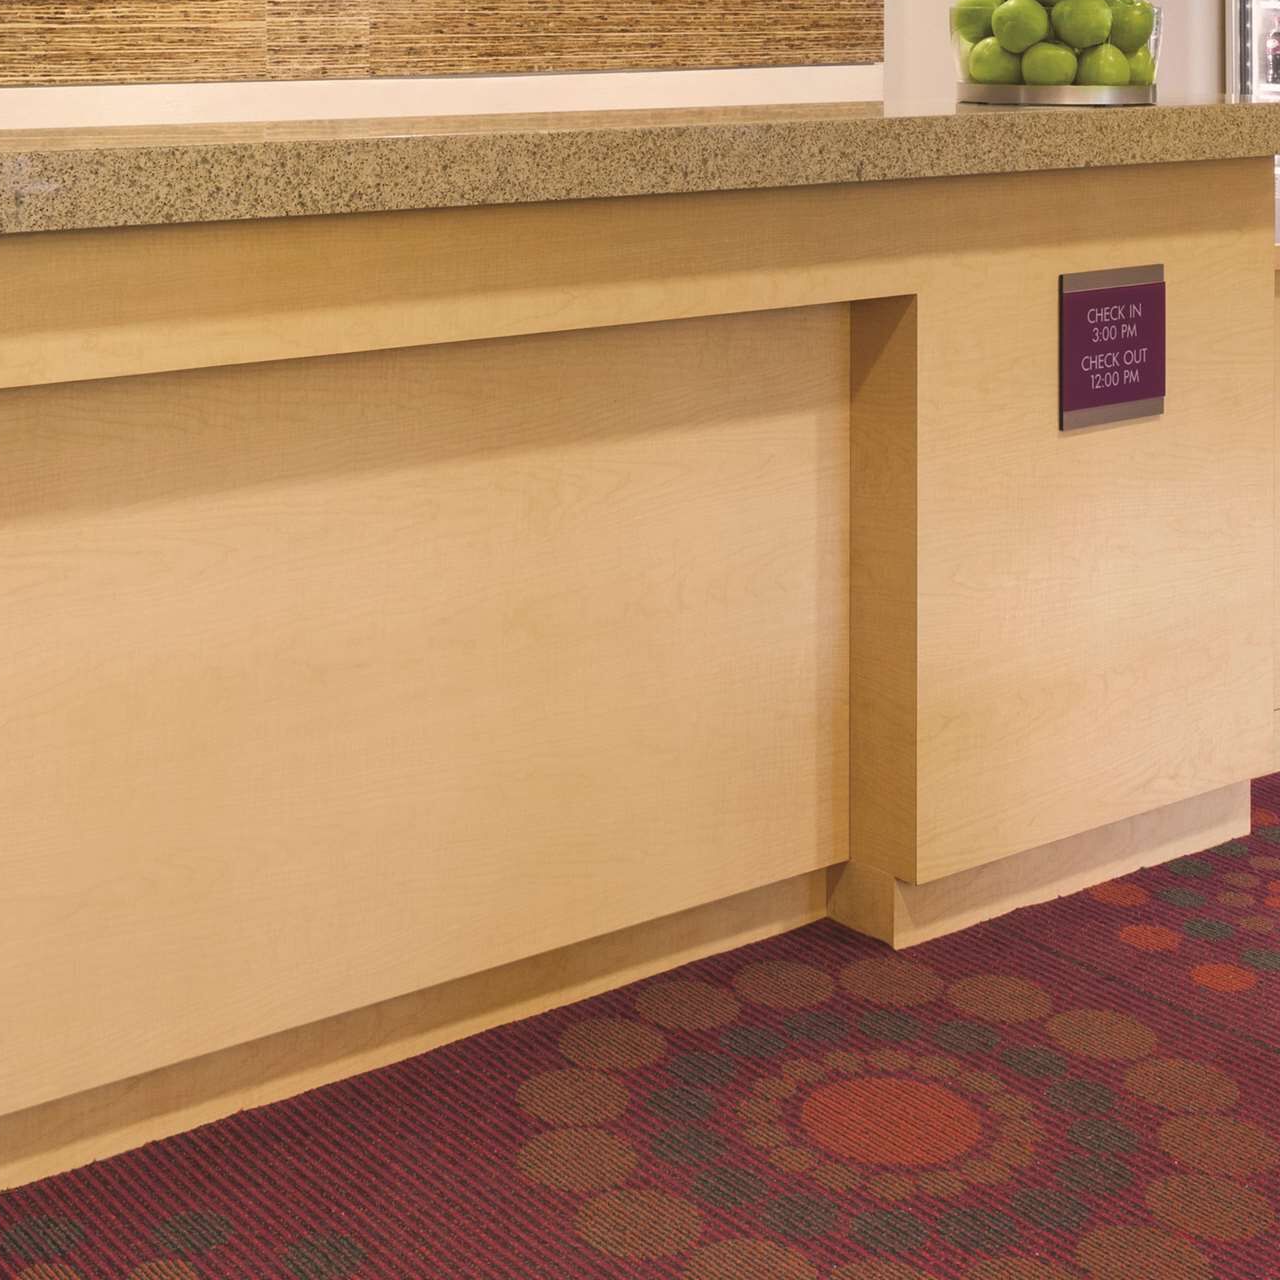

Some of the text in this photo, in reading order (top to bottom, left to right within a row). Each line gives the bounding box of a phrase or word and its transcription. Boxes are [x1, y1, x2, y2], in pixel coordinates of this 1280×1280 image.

[1087, 304, 1142, 323] CHECK IN
[1092, 324, 1138, 343] 3:00 PM
[1081, 348, 1148, 371] CHECK OUT
[1090, 370, 1140, 389] 12:00 PM
